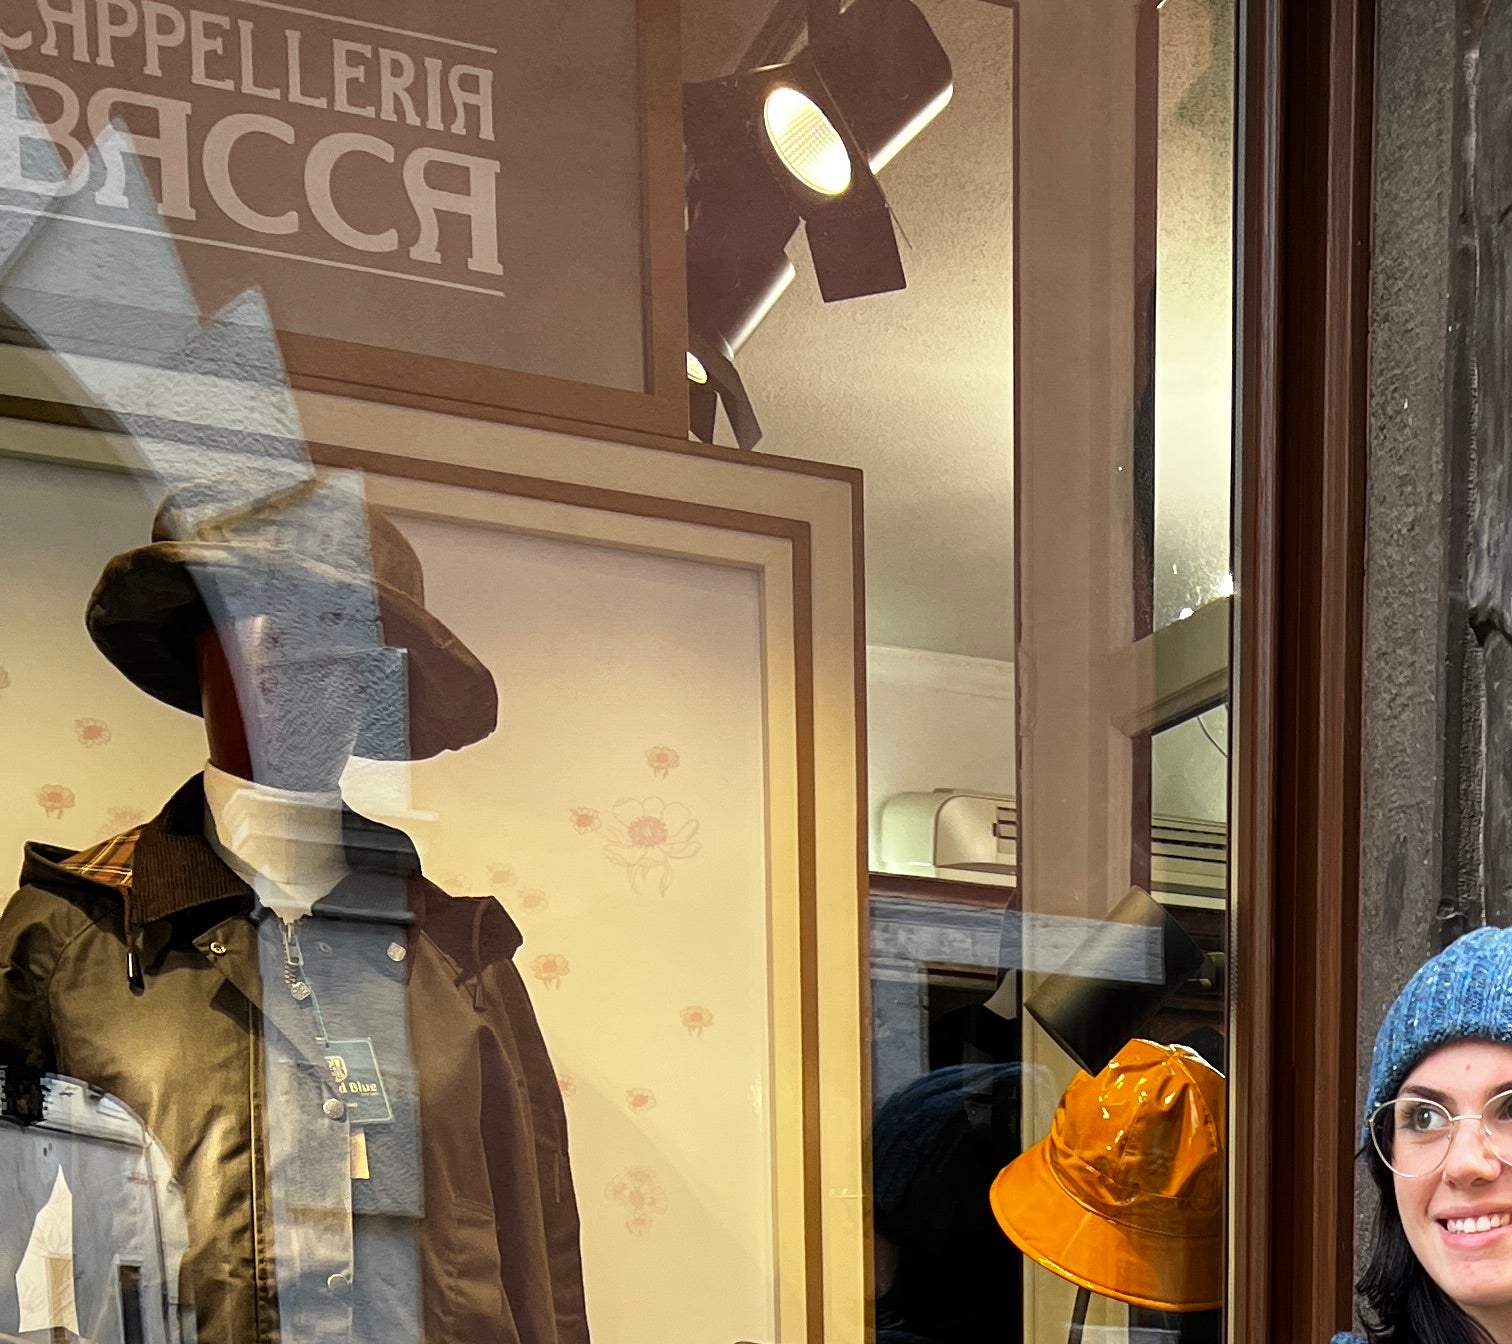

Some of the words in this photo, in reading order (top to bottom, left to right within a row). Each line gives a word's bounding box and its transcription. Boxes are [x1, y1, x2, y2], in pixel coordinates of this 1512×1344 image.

[0, 0, 496, 141] APPELLERIA
[0, 67, 505, 276] BACCA
[348, 1081, 378, 1093] Blue
